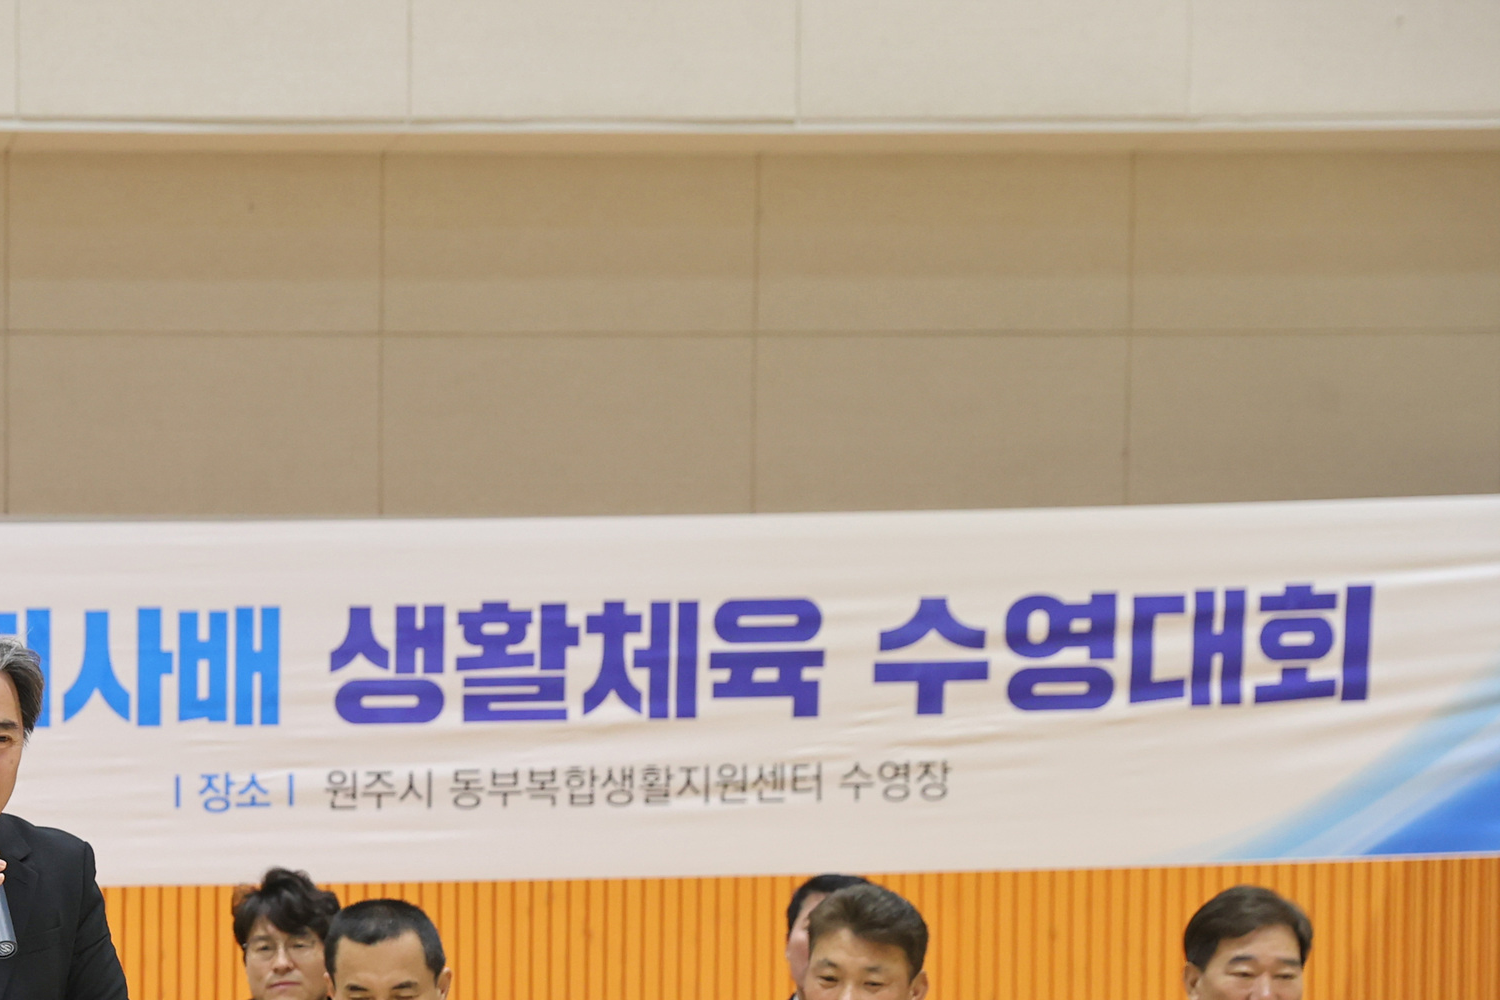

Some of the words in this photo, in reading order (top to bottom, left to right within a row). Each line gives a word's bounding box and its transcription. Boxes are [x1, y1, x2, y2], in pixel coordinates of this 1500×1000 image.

[330, 597, 824, 724] 생활체육
[874, 583, 1373, 714] 수영대회
[199, 772, 271, 813] 장소
[324, 769, 433, 812] 원주시
[449, 761, 824, 812] 동부복합생활지원센터
[838, 760, 952, 803] 수영장
